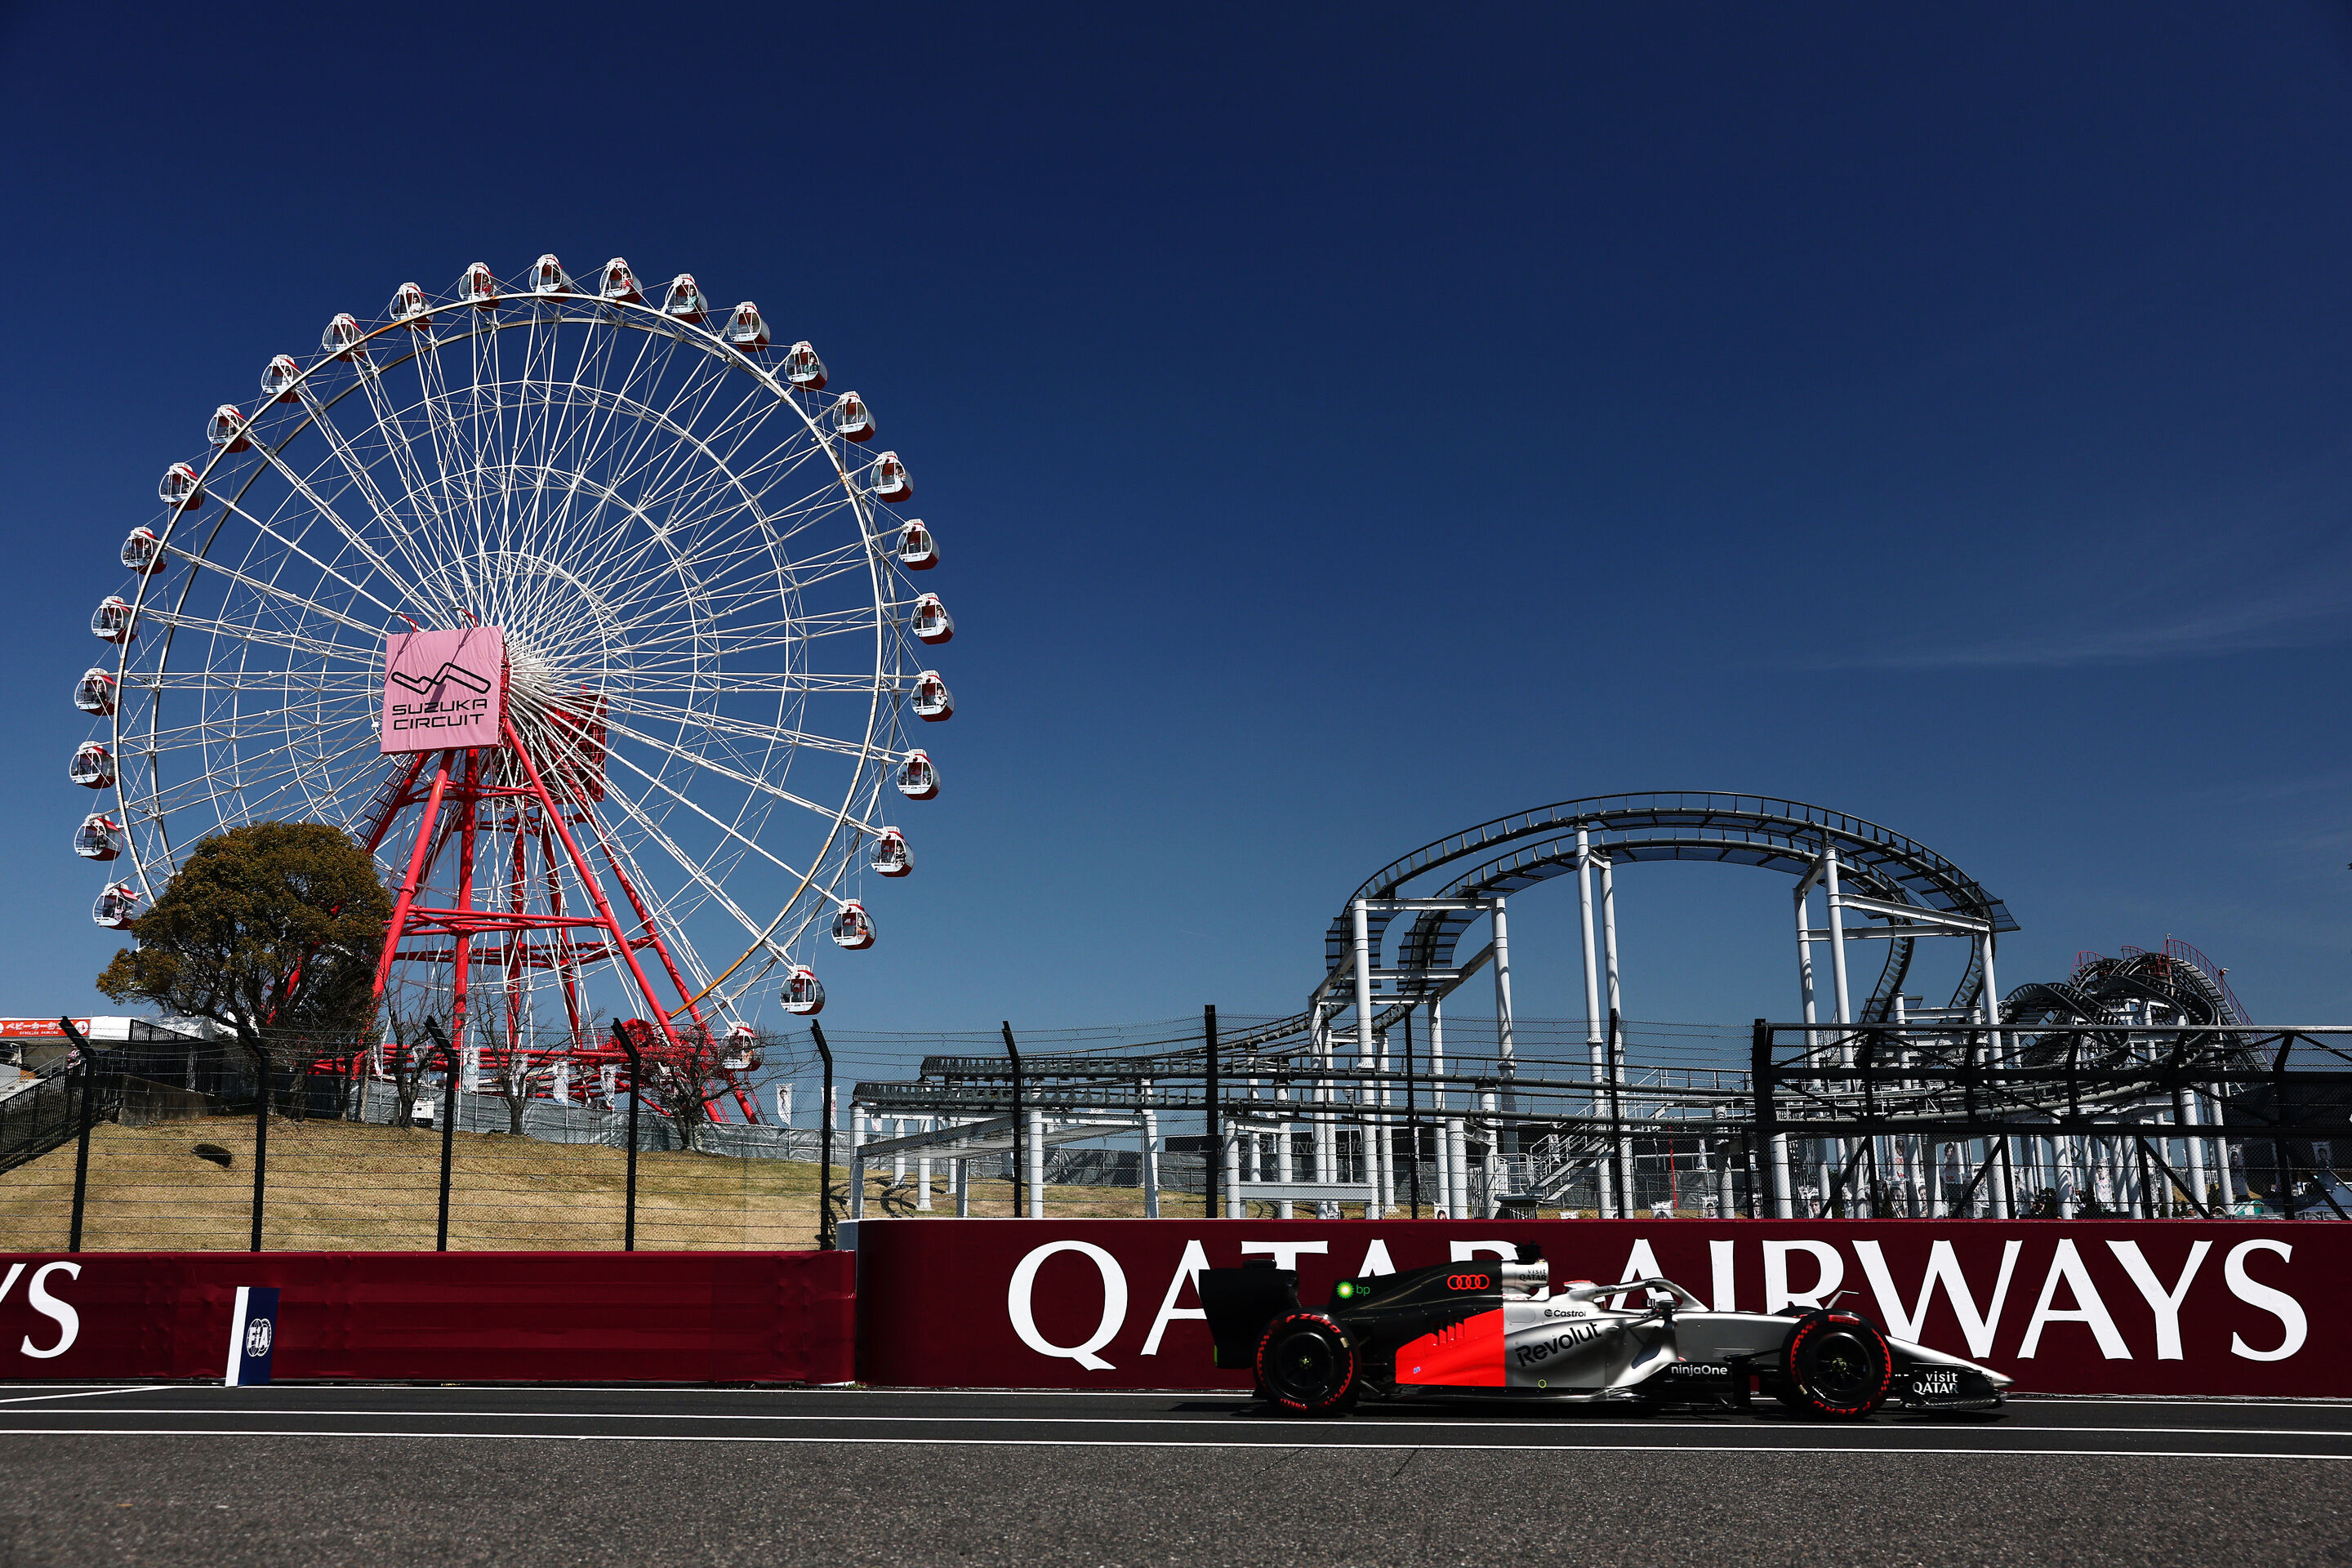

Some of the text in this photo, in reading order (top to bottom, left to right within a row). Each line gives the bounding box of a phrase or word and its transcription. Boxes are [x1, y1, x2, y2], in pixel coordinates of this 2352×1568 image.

[392, 698, 488, 715] SUZUKA
[394, 713, 484, 730] CIRCUIT
[1356, 1284, 1370, 1297] bp
[1008, 1238, 2309, 1371] QAT AIRWAYS
[1553, 1309, 1587, 1317] Castrol
[1515, 1322, 1602, 1367] Revolut
[1671, 1364, 1728, 1376] ninjaOne
[1926, 1370, 1958, 1383] visit
[1912, 1381, 1959, 1395] QATAR
